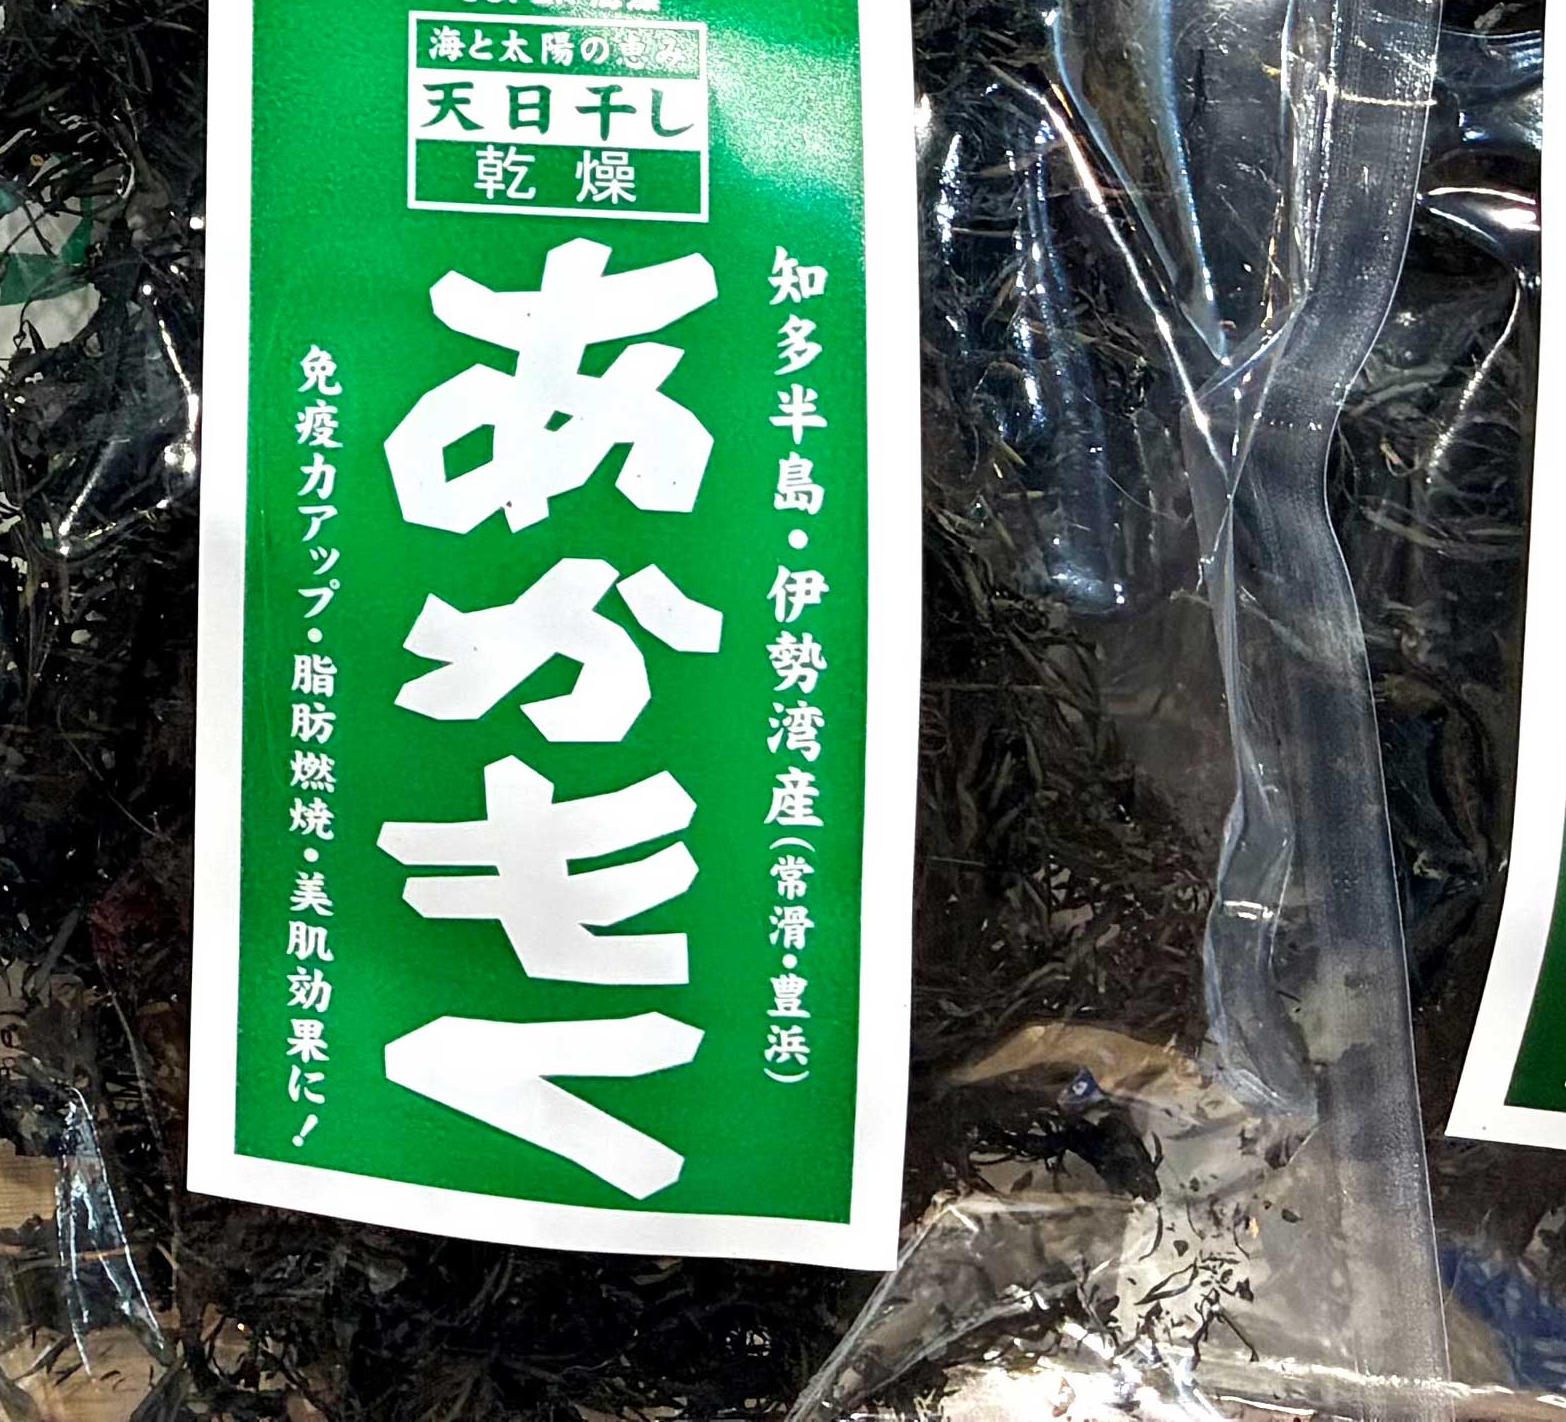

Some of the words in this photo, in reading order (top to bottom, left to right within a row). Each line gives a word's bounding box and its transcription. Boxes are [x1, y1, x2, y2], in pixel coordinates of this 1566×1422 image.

[428, 26, 698, 71] 海と太陽の恵み
[420, 80, 695, 143] 天日干し
[473, 144, 638, 206] 乾燥
[376, 237, 724, 1200] あかもく
